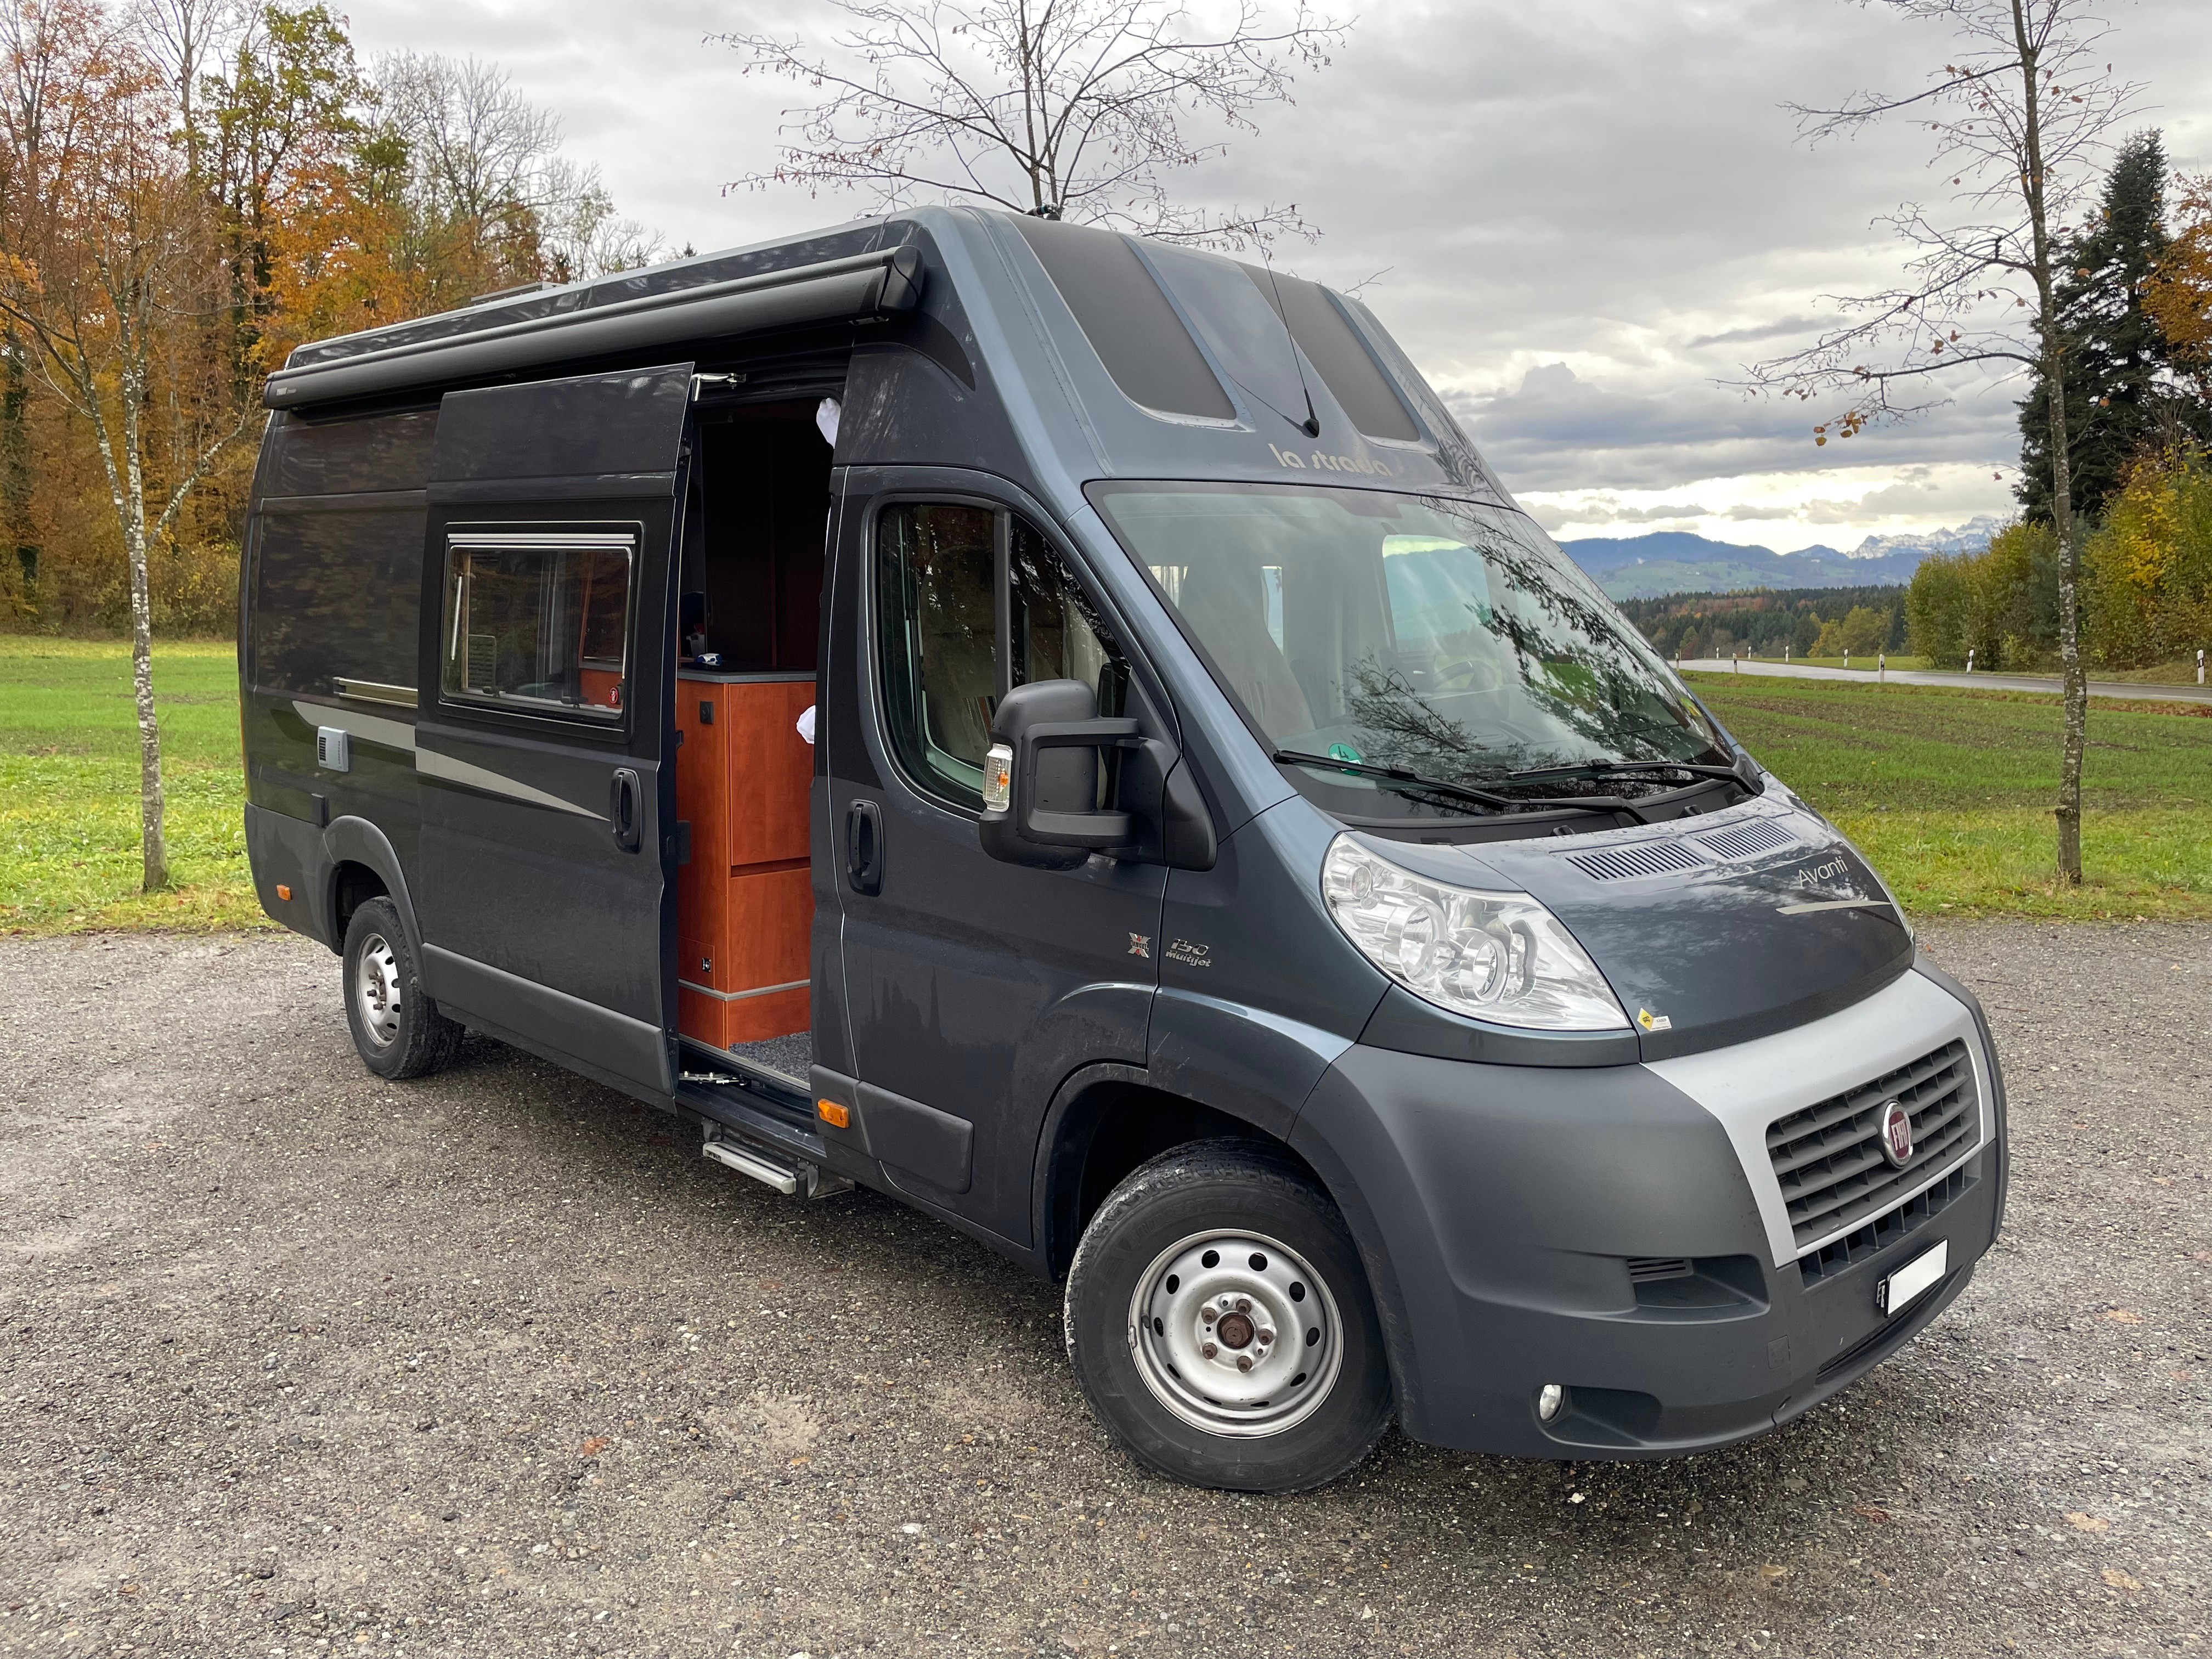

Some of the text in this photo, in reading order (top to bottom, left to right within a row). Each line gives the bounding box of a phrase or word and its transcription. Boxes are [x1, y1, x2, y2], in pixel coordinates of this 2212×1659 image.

[1268, 443, 1393, 476] la strada
[1338, 746, 1349, 759] 4
[1798, 855, 1848, 889] Avanti
[1165, 950, 1211, 967] Multijet
